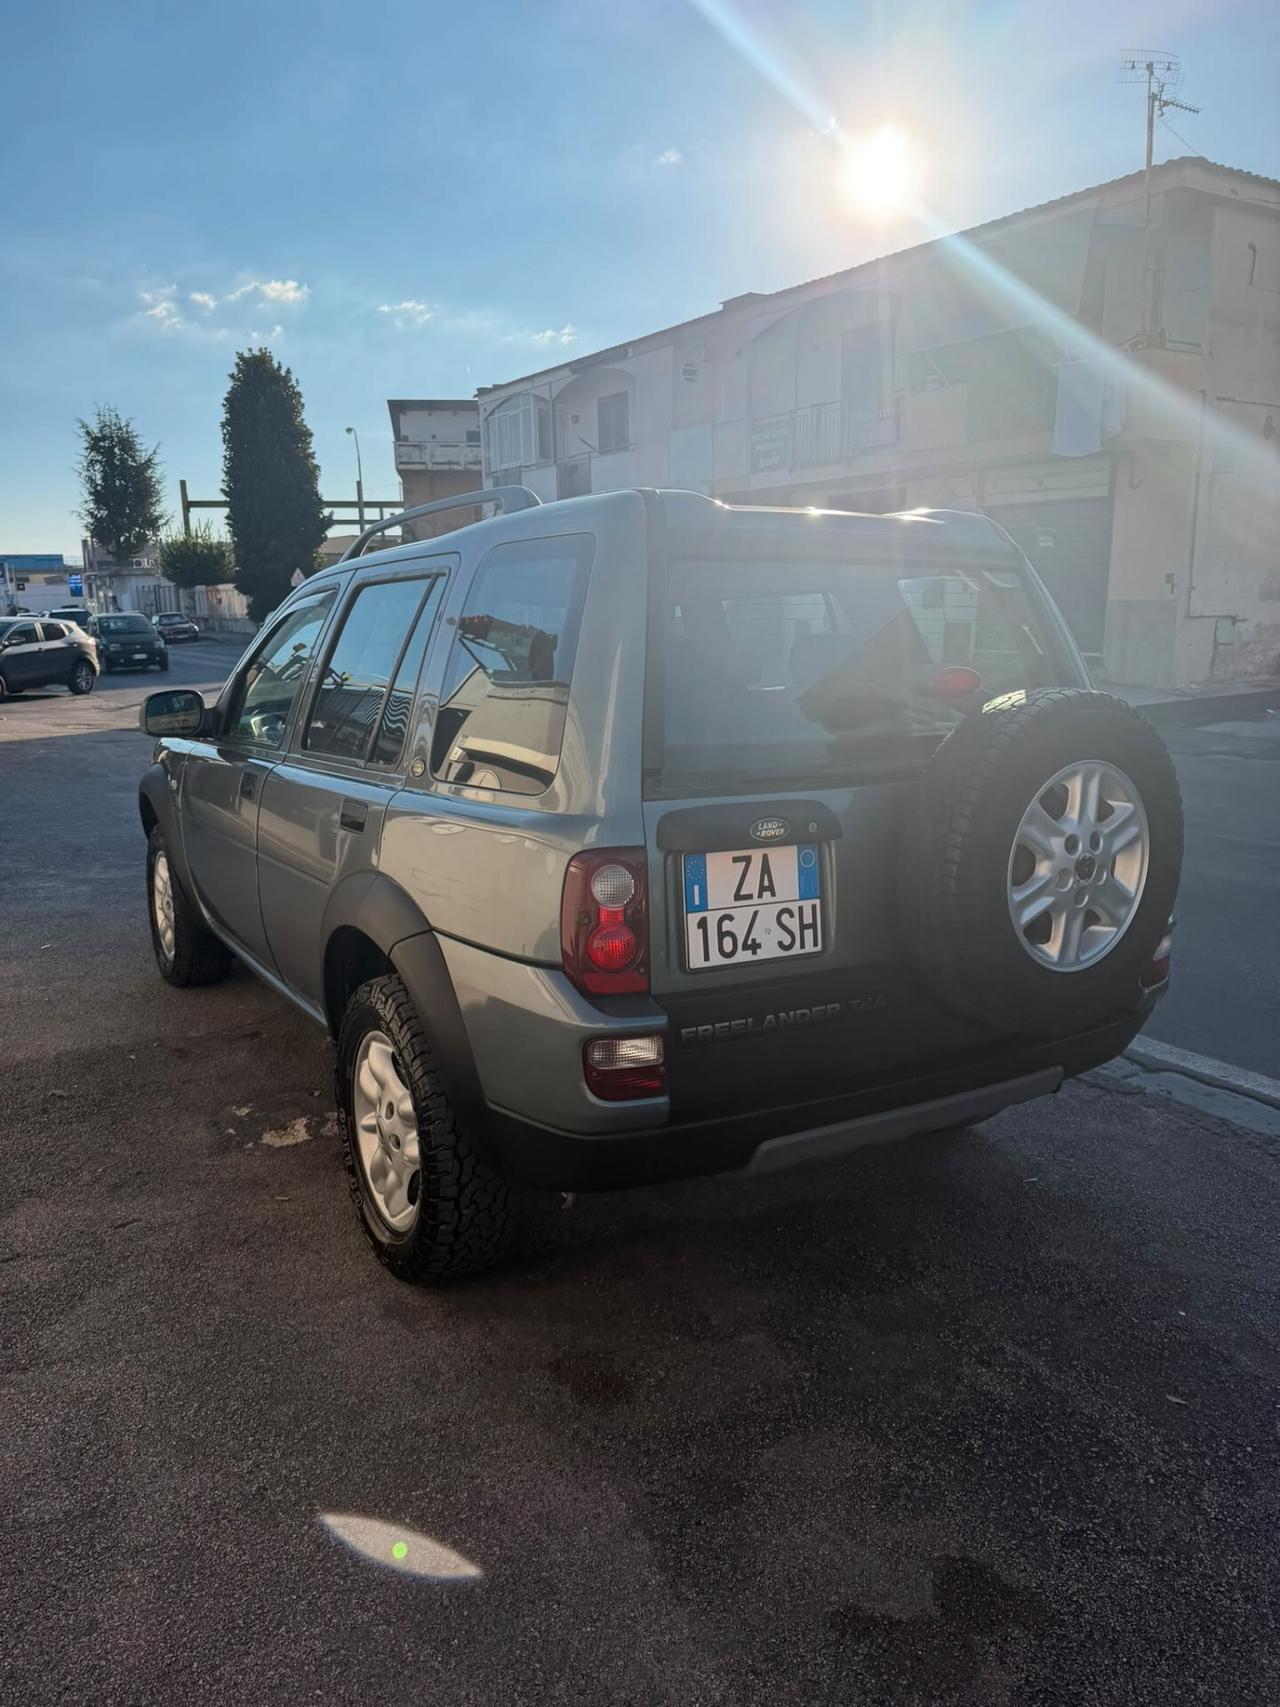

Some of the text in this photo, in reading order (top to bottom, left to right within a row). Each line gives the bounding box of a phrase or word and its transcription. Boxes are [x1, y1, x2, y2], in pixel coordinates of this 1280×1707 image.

[758, 821, 779, 830] LAND
[760, 827, 785, 838] ROVER
[732, 853, 777, 902] ZA
[697, 903, 820, 963] 164 SH
[680, 1002, 841, 1044] FREELANDER
